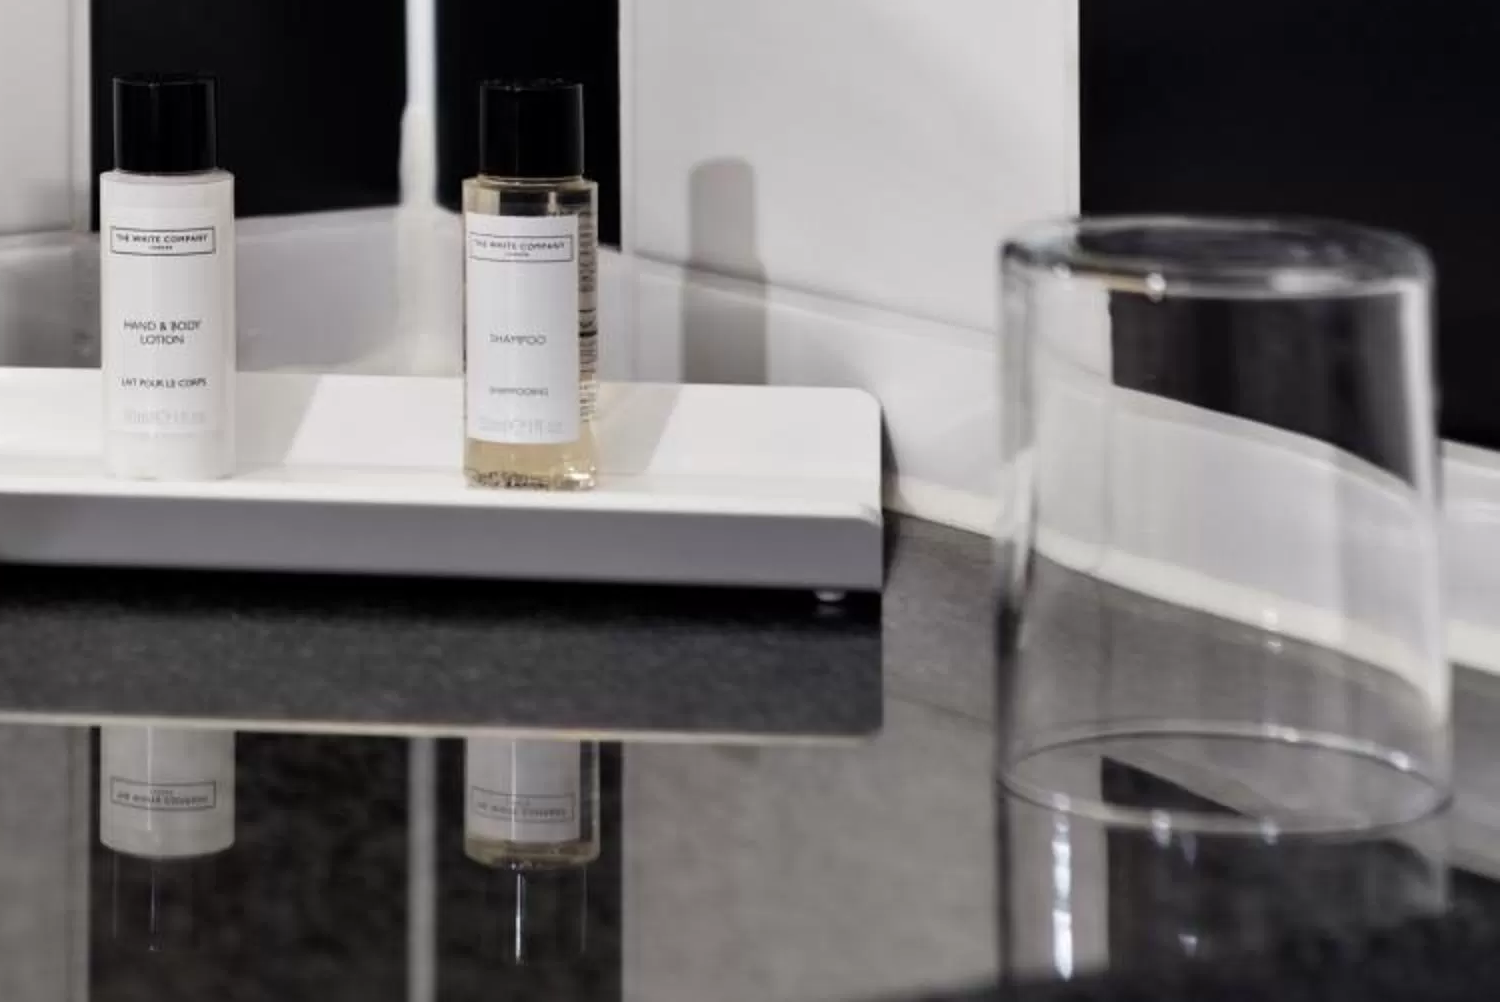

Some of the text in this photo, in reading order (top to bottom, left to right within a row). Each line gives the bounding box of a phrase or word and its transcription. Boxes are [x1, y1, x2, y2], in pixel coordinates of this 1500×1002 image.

[115, 233, 209, 244] THE WHITE COMPANY
[519, 241, 566, 251] COMPANY
[123, 318, 202, 331] HAND & BODY
[139, 334, 185, 345] LOTION
[489, 333, 548, 345] SHAMPOO
